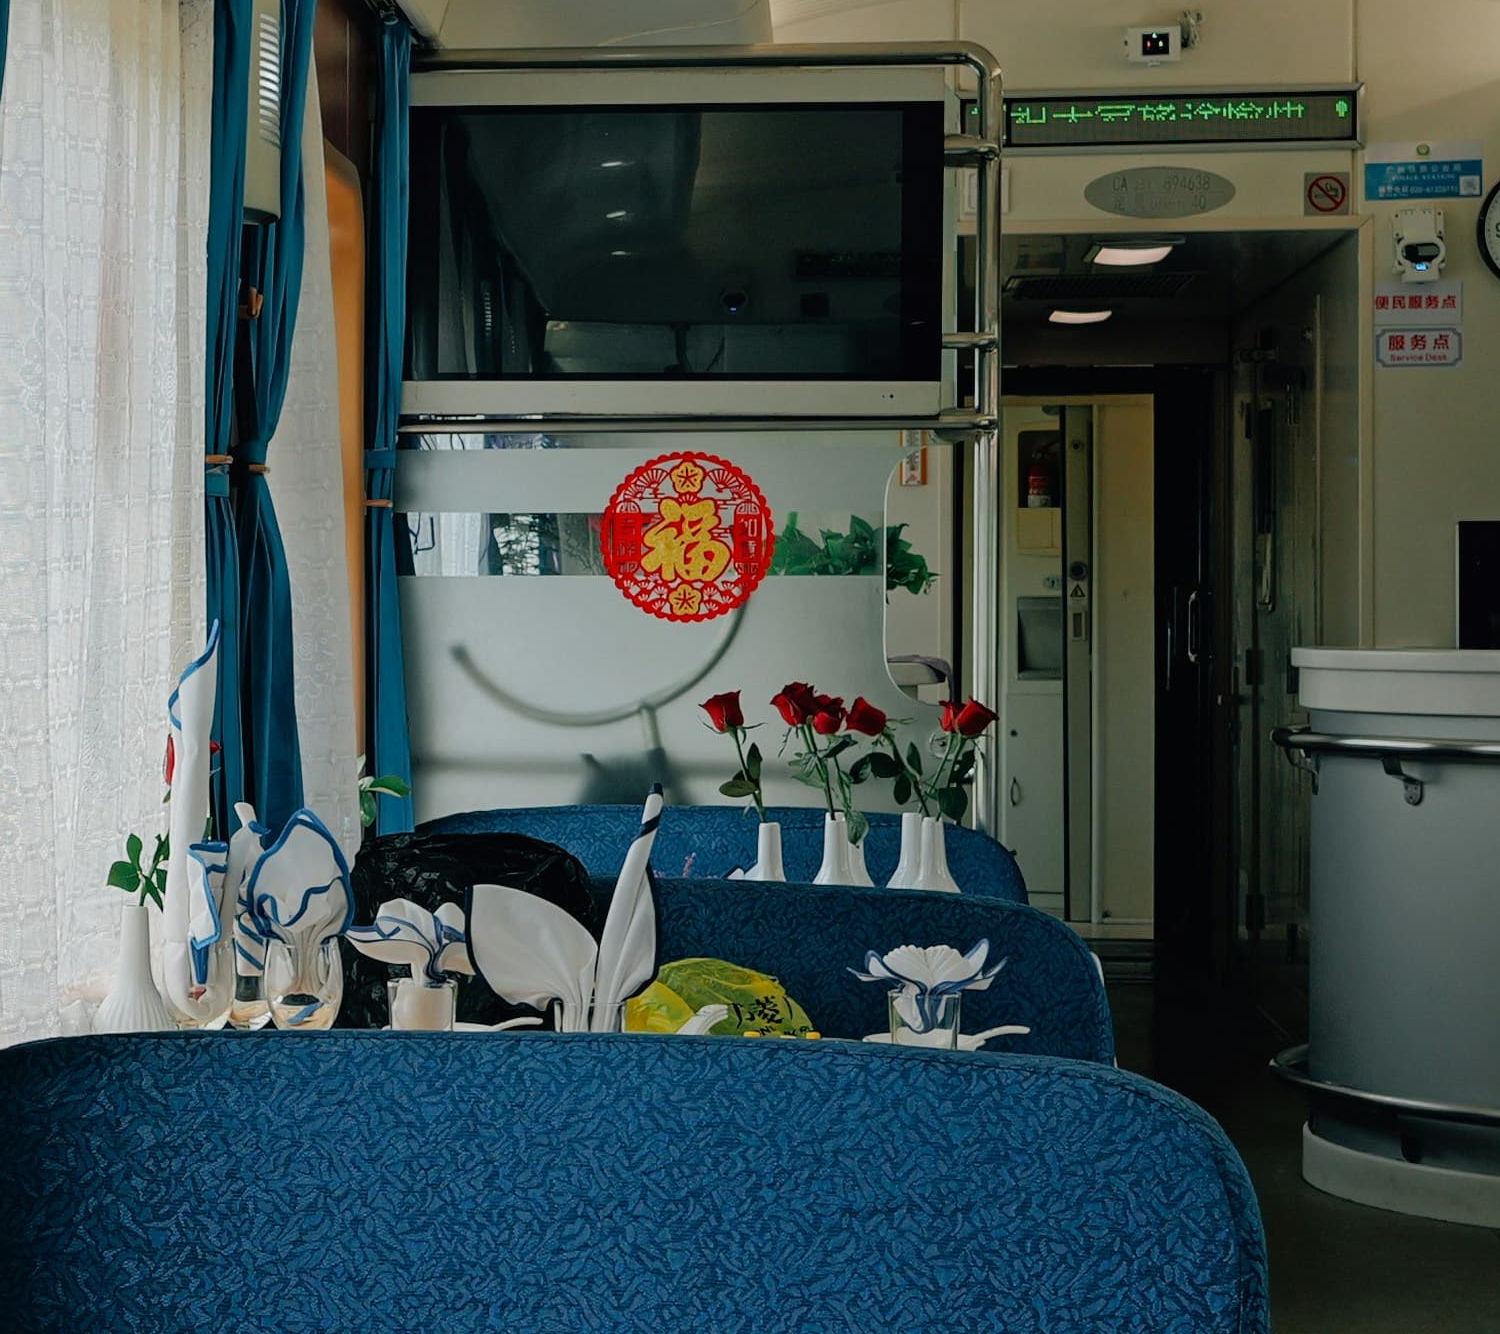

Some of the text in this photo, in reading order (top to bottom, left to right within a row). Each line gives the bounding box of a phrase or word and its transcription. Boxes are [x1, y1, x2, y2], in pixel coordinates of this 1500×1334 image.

[1375, 294, 1457, 310] 便民服务点
[1387, 333, 1450, 351] 服务点
[1390, 353, 1448, 363] Service Desk
[640, 498, 732, 582] 福
